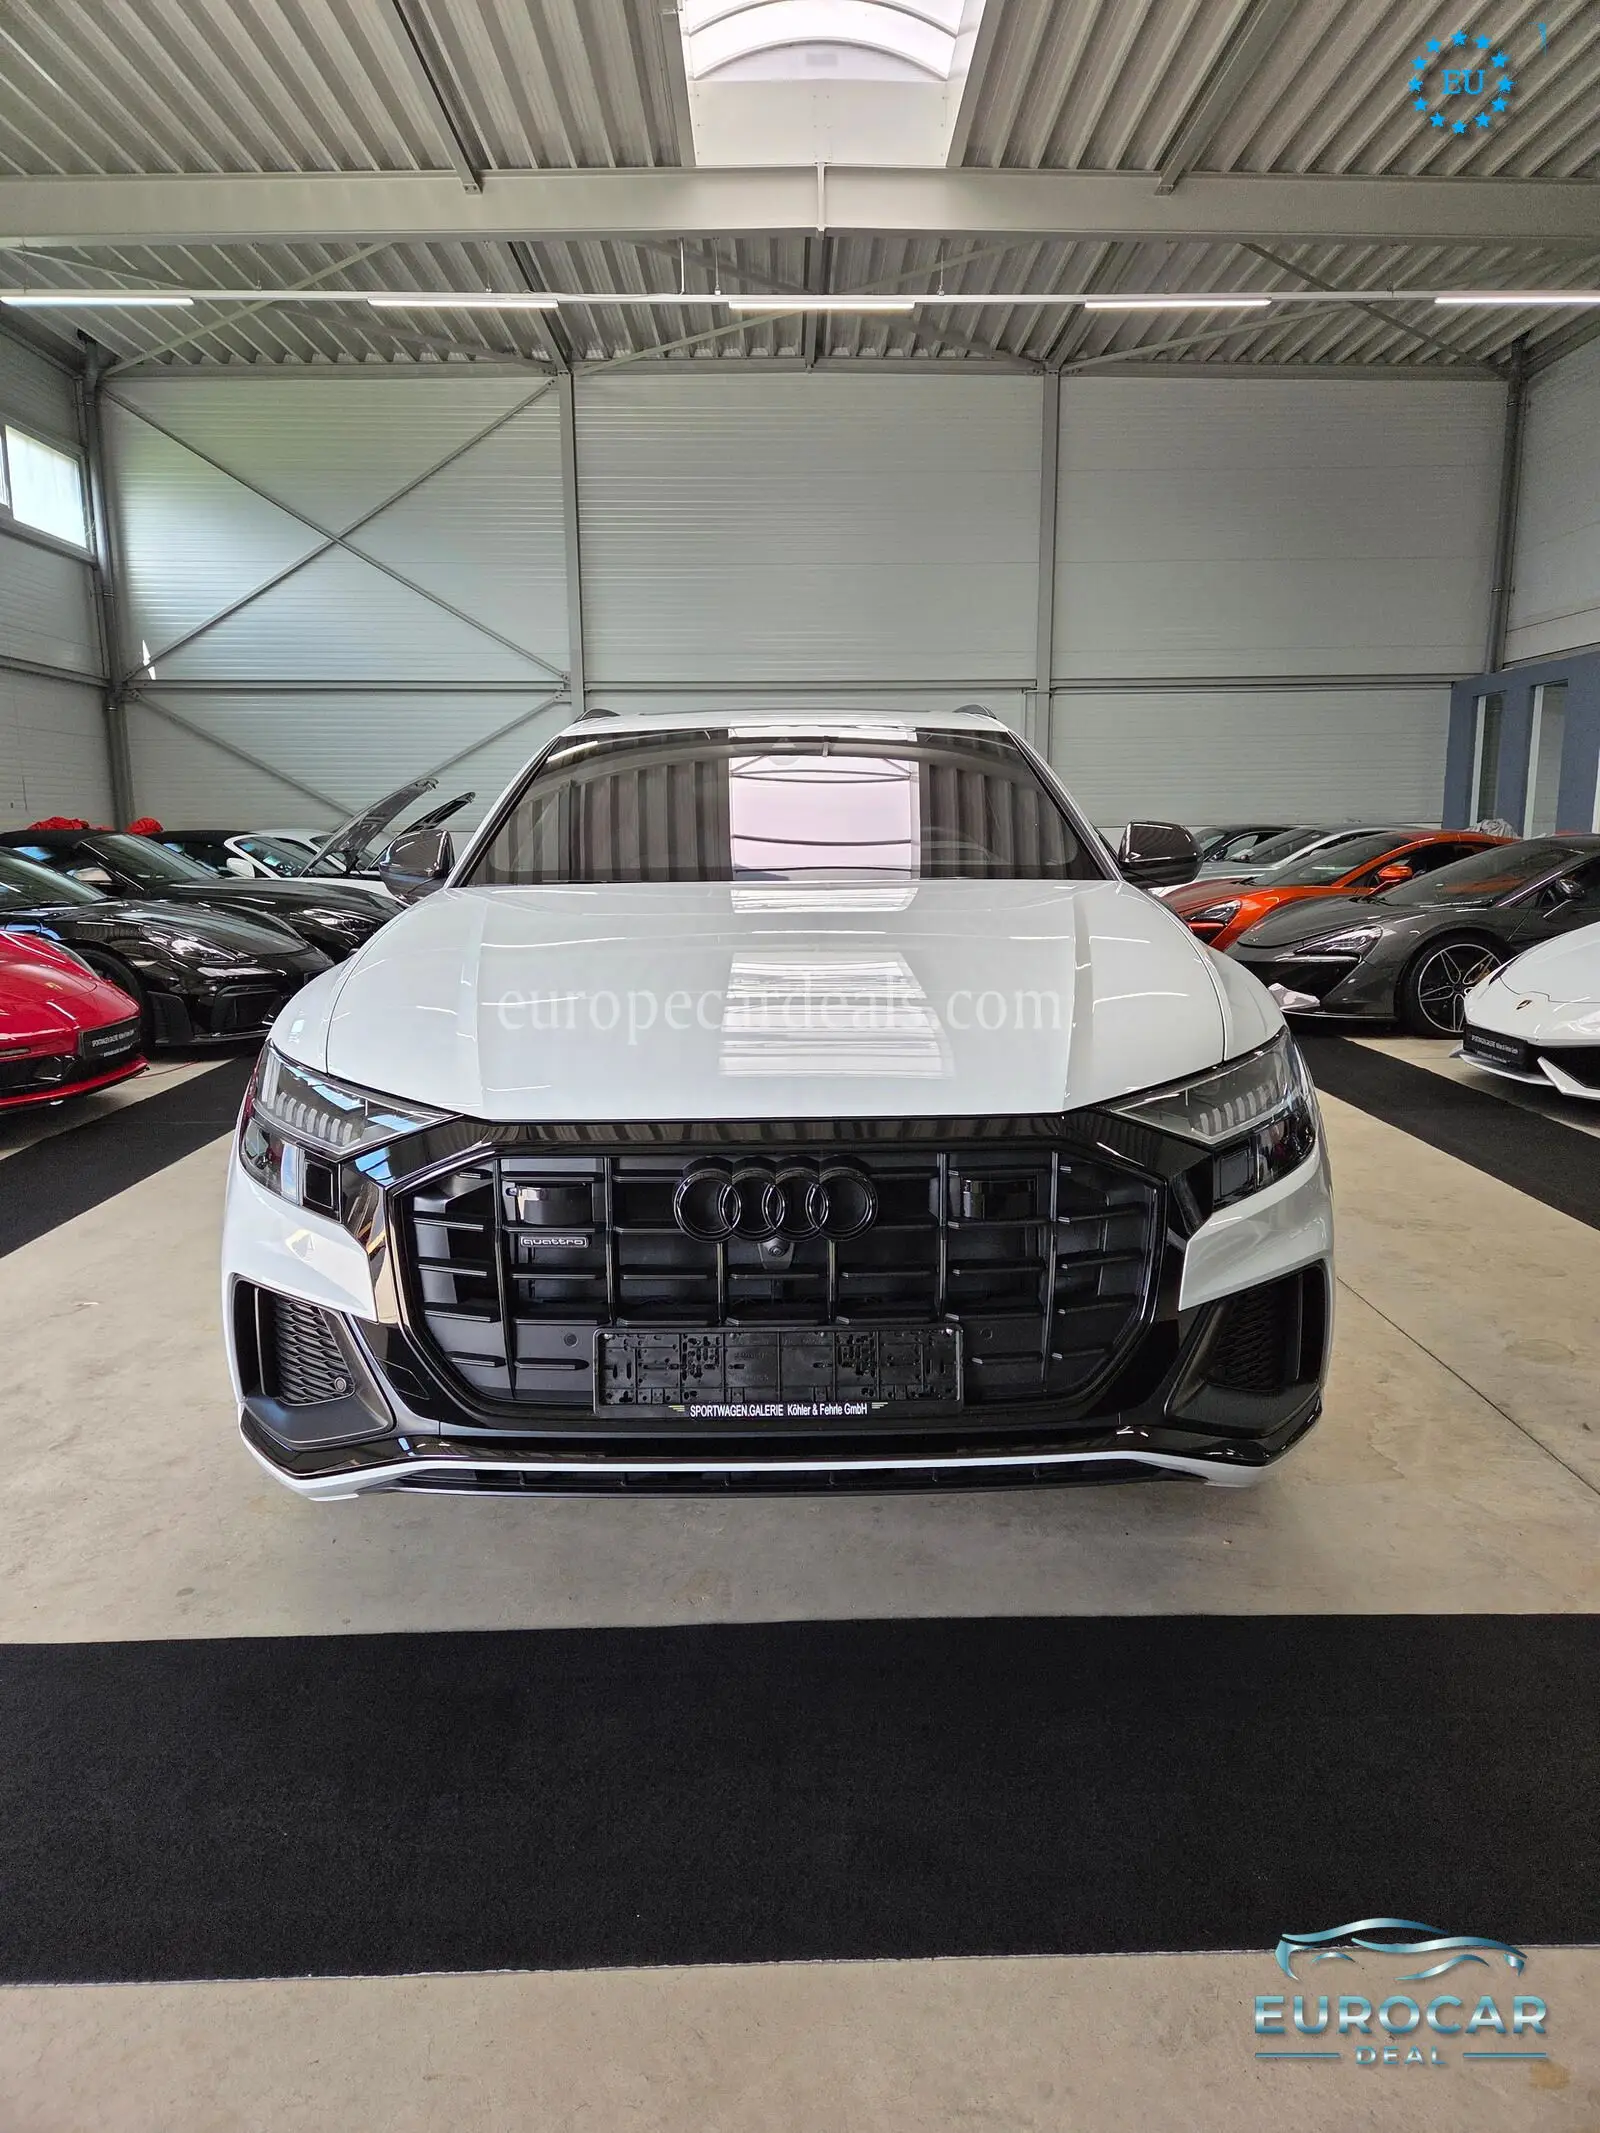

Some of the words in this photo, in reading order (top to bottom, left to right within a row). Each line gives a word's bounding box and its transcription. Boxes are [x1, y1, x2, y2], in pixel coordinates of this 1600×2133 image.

[523, 1238, 584, 1246] quattro
[689, 1403, 784, 1418] SPORTWAGEN.GALERIE
[787, 1402, 811, 1416] Köhler
[812, 1404, 818, 1416] &
[819, 1402, 843, 1416] Fehrle
[844, 1402, 868, 1415] GmbH
